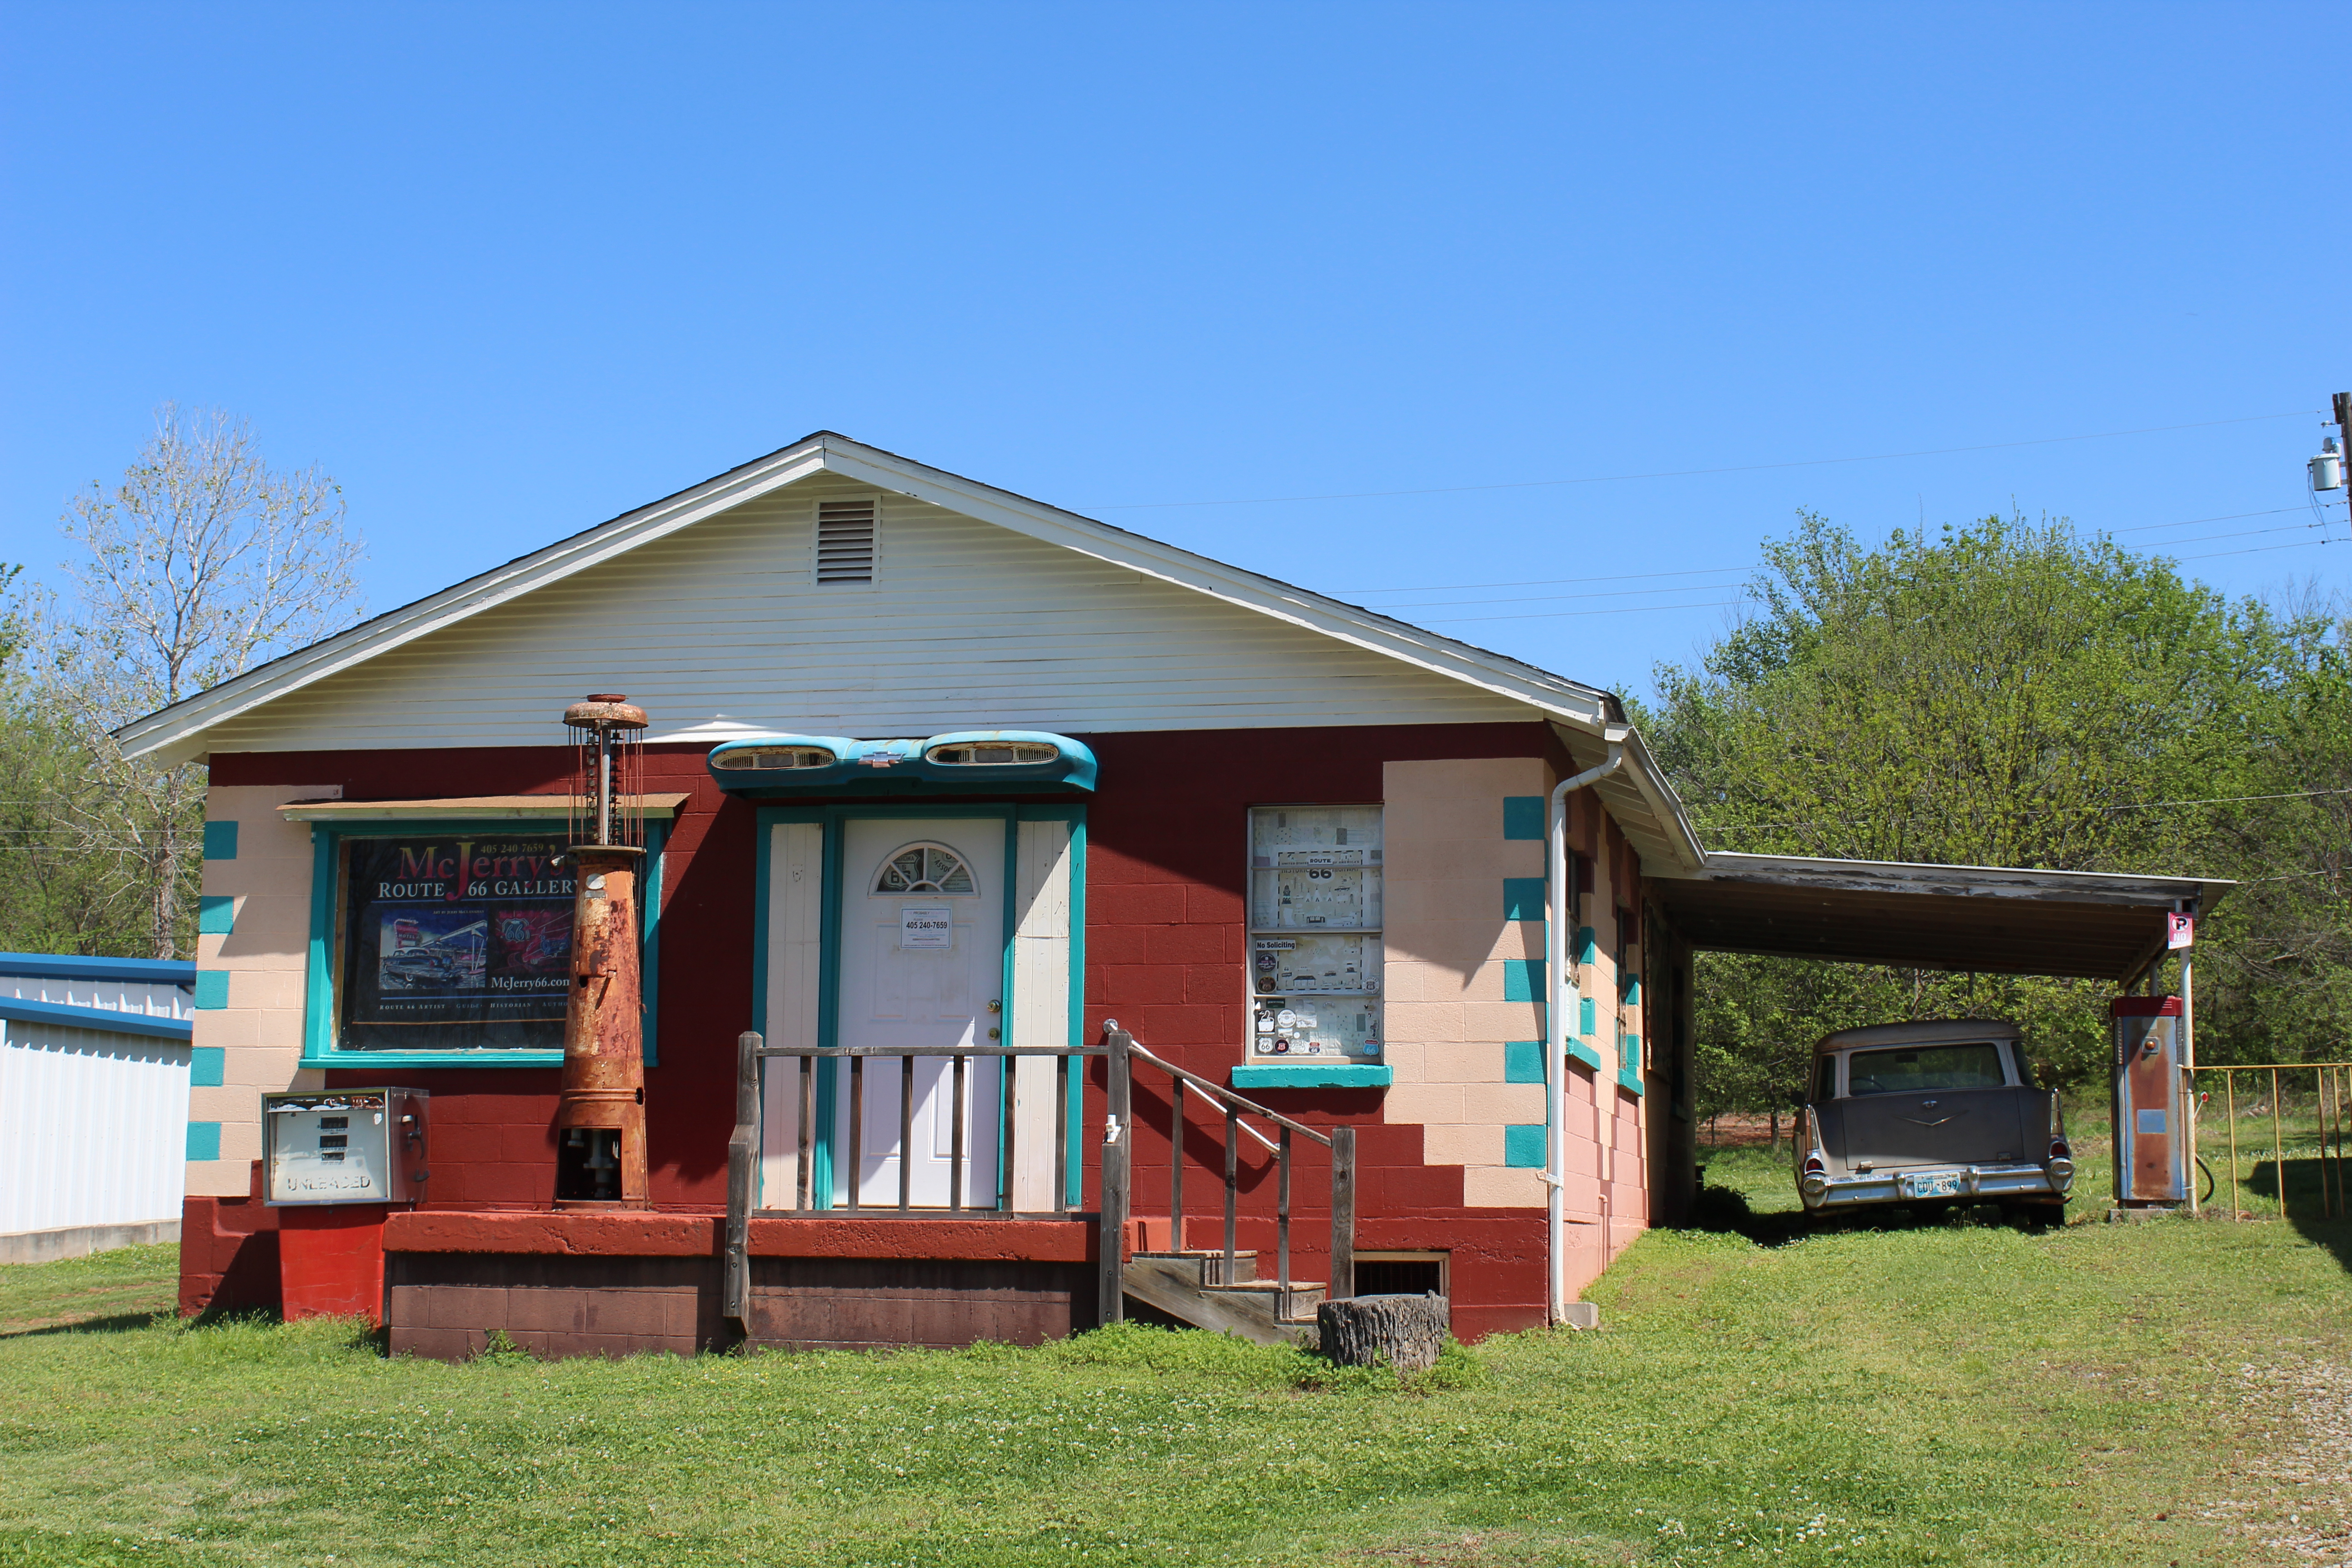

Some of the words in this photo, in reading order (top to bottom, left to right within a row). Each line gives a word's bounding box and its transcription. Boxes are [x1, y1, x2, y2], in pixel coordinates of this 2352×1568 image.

[481, 844, 497, 853] 405
[501, 844, 518, 853] 240
[522, 843, 544, 852] 7659
[1309, 868, 1332, 879] 66
[378, 882, 445, 898] ROUTE
[468, 881, 487, 897] 66
[505, 924, 524, 941] 66
[2174, 933, 2186, 941] NO
[1917, 1181, 1934, 1193] CDU
[1942, 1180, 1957, 1191] 899
